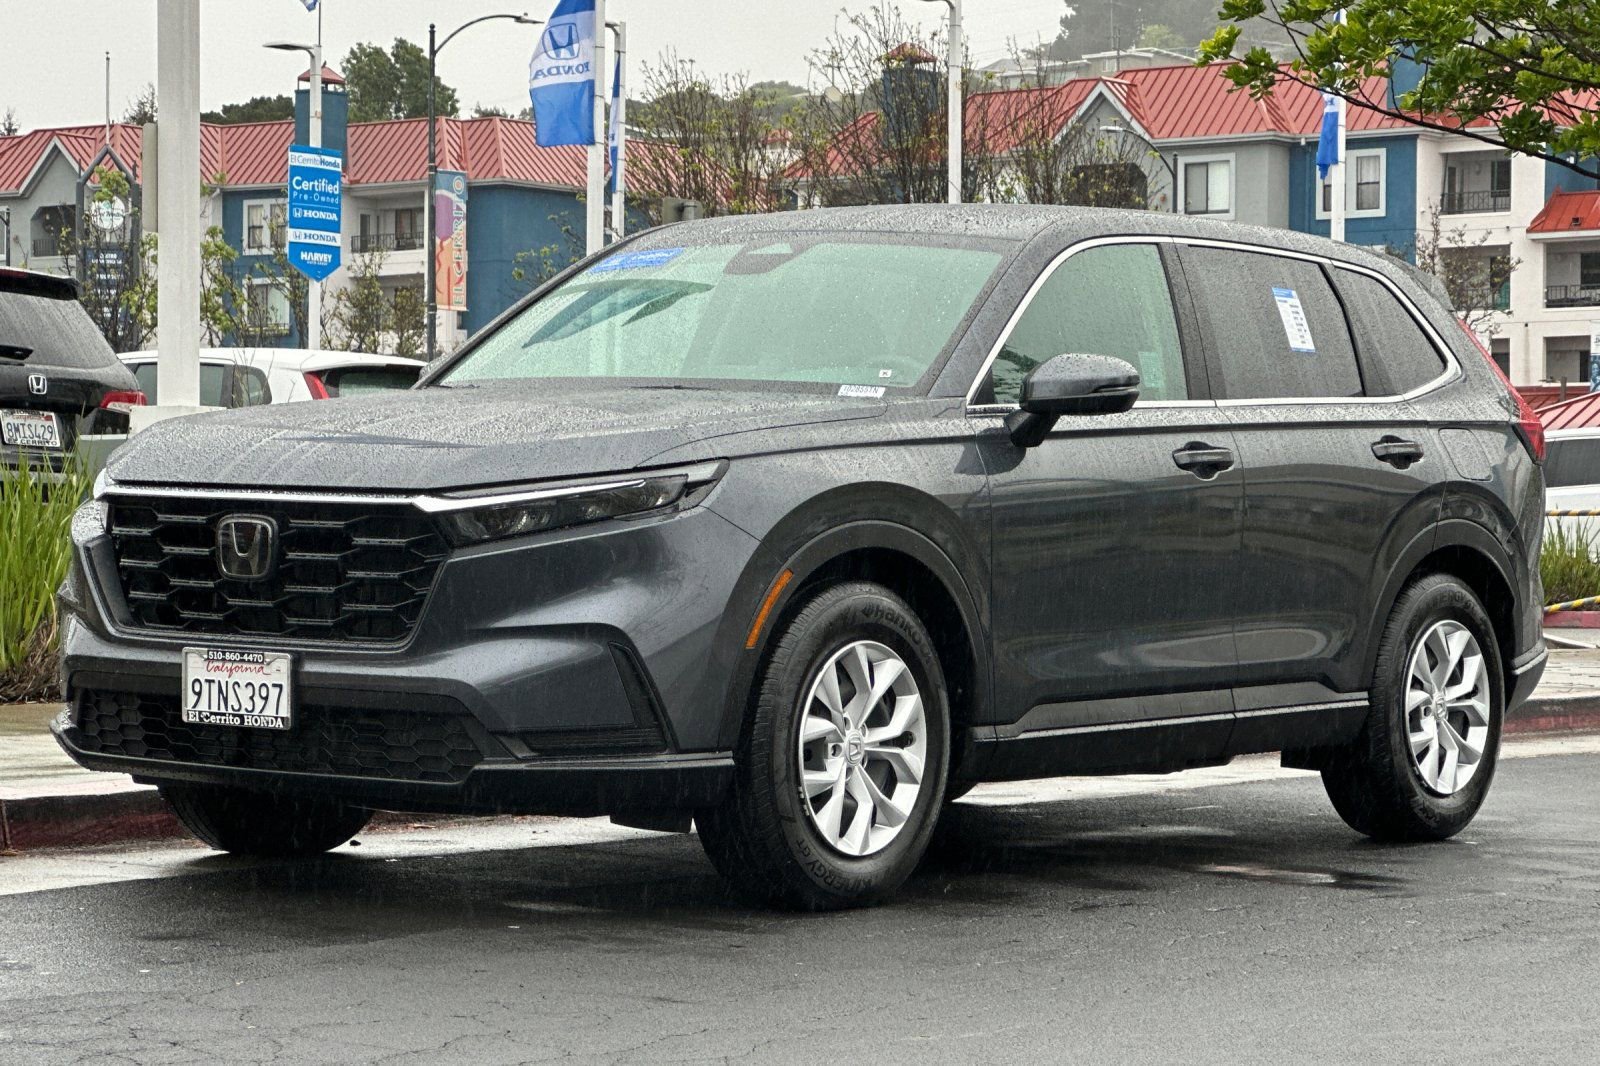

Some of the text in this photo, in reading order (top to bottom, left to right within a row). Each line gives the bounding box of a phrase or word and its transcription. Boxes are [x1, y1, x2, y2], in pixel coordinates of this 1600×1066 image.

[292, 176, 340, 195] Certified
[292, 190, 339, 204] Pre-Owned
[303, 209, 338, 221] HONDA
[303, 232, 338, 243] HONDA
[452, 175, 465, 306] EL CERRITO
[300, 251, 333, 263] HARVEY
[6, 422, 54, 441] 8MIS429
[208, 651, 263, 663] 510-860-4470
[206, 660, 271, 679] California
[191, 678, 284, 715] 9TNS397
[188, 711, 284, 729] El Cerrito HONDA
